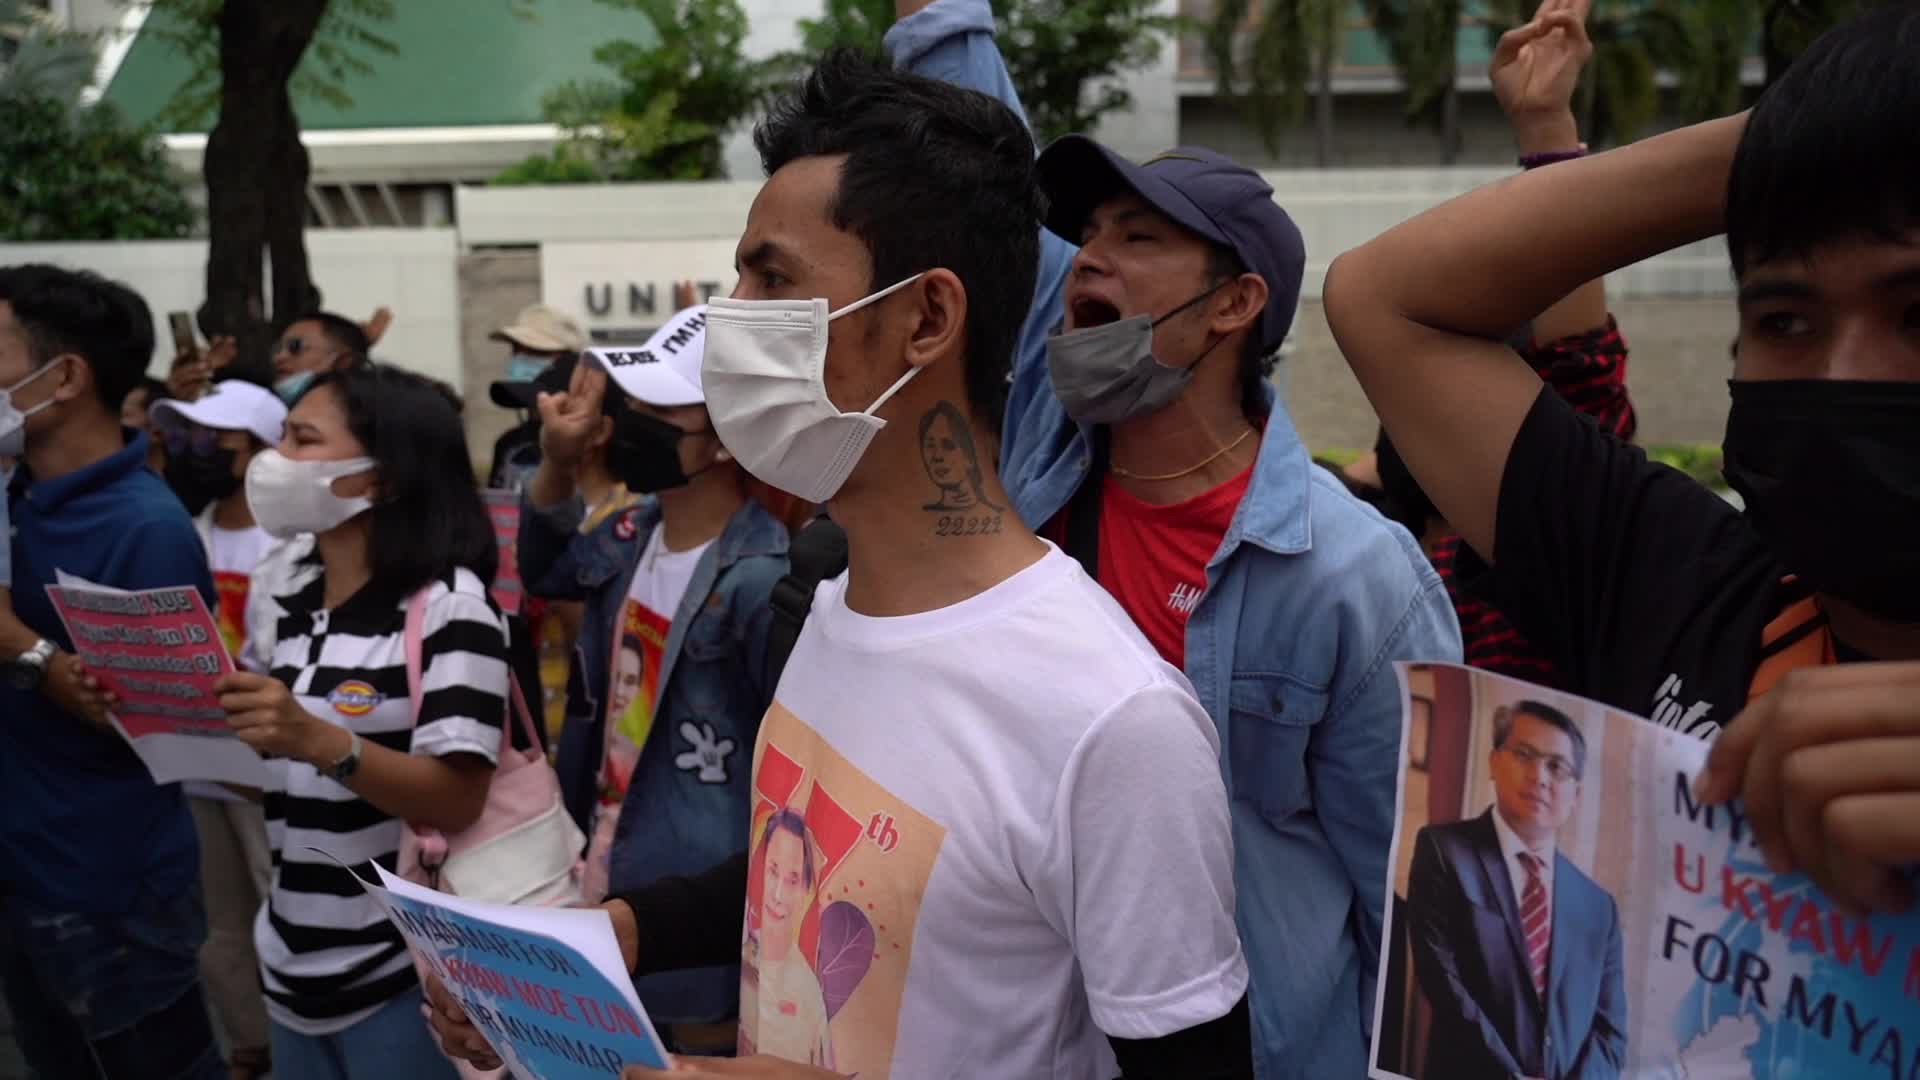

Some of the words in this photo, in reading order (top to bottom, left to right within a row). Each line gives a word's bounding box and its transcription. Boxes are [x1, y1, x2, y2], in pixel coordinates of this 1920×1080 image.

[935, 514, 1003, 537] 22222
[391, 905, 521, 962] MYANMAR
[1674, 843, 1704, 894] U
[1721, 864, 1895, 977] KYAW
[1662, 914, 1771, 1009] FOR
[511, 975, 578, 1022] MOE
[572, 994, 642, 1039] TUN
[495, 1009, 624, 1075] MYANMAR
